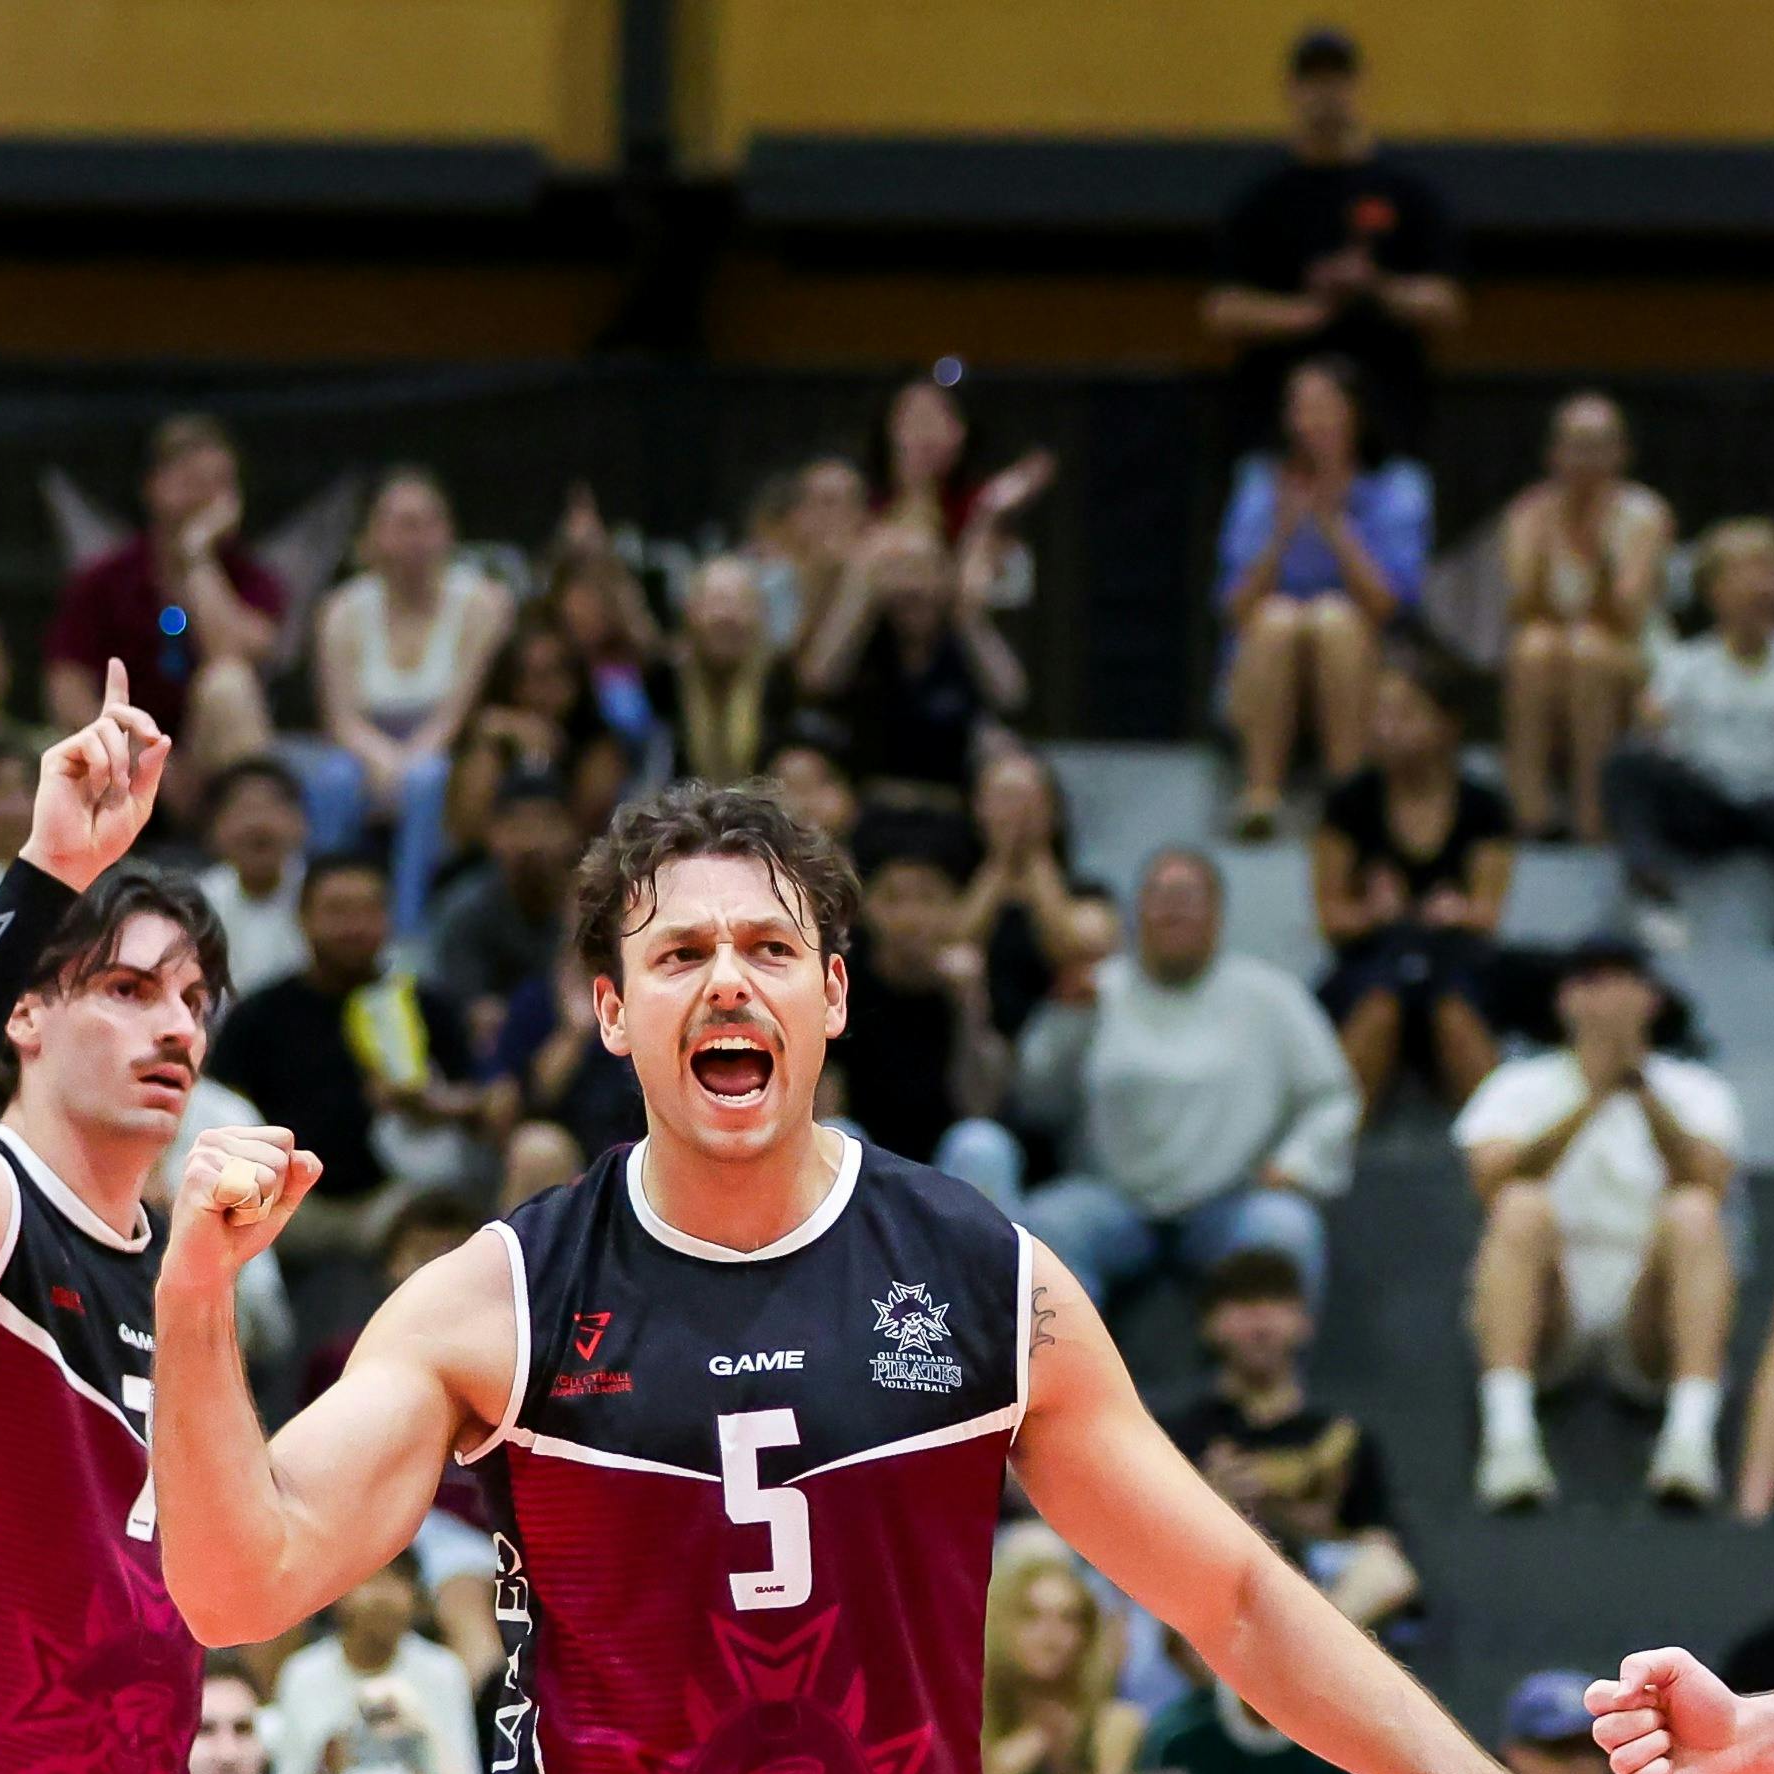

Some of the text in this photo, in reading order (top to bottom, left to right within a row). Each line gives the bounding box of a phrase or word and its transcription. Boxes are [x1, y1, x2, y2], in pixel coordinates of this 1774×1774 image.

[708, 1350, 805, 1376] GAME
[877, 1351, 954, 1364] QUEENSLAND
[869, 1359, 963, 1387] PIRATES
[880, 1380, 951, 1393] VOLLEYBALL
[717, 1408, 813, 1611] 5
